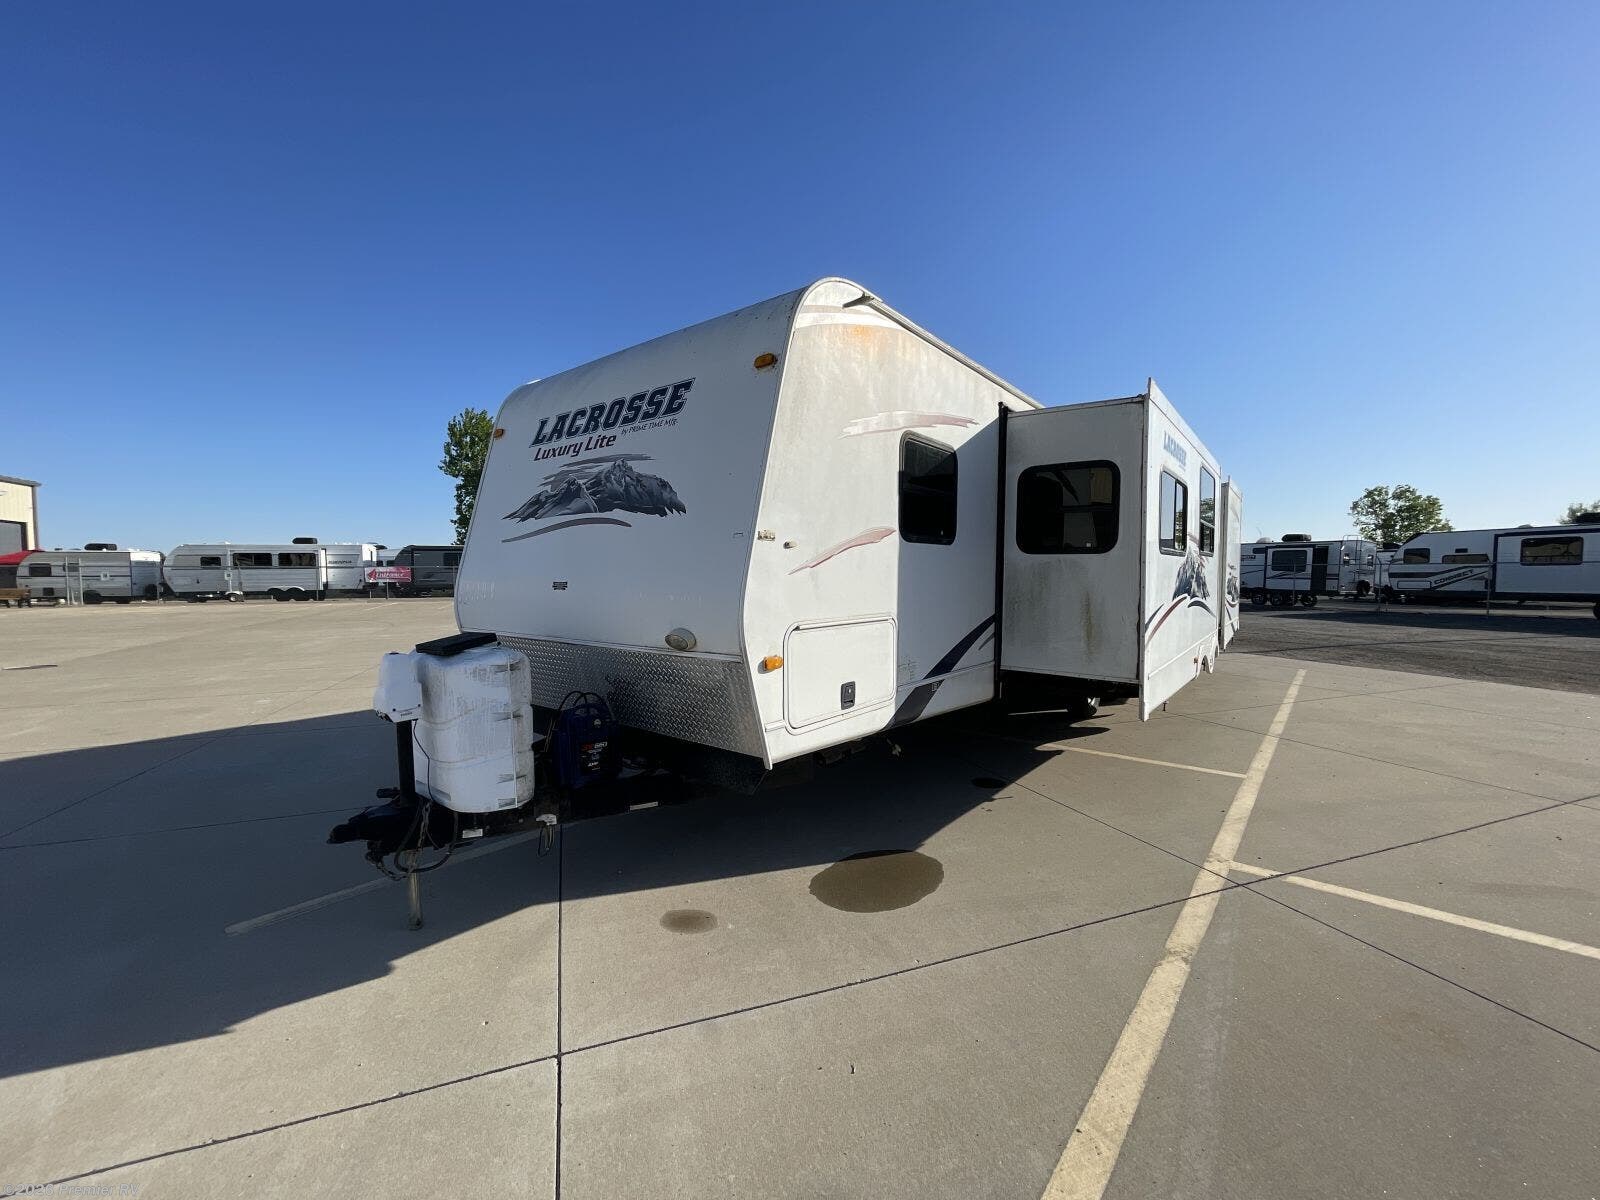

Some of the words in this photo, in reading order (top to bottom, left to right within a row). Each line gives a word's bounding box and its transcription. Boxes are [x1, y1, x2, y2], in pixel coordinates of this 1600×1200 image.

[529, 377, 696, 448] LACROSSE
[629, 423, 648, 433] PRIME
[649, 420, 664, 429] TIME
[534, 442, 583, 461] Luxury
[584, 434, 617, 451] Lite
